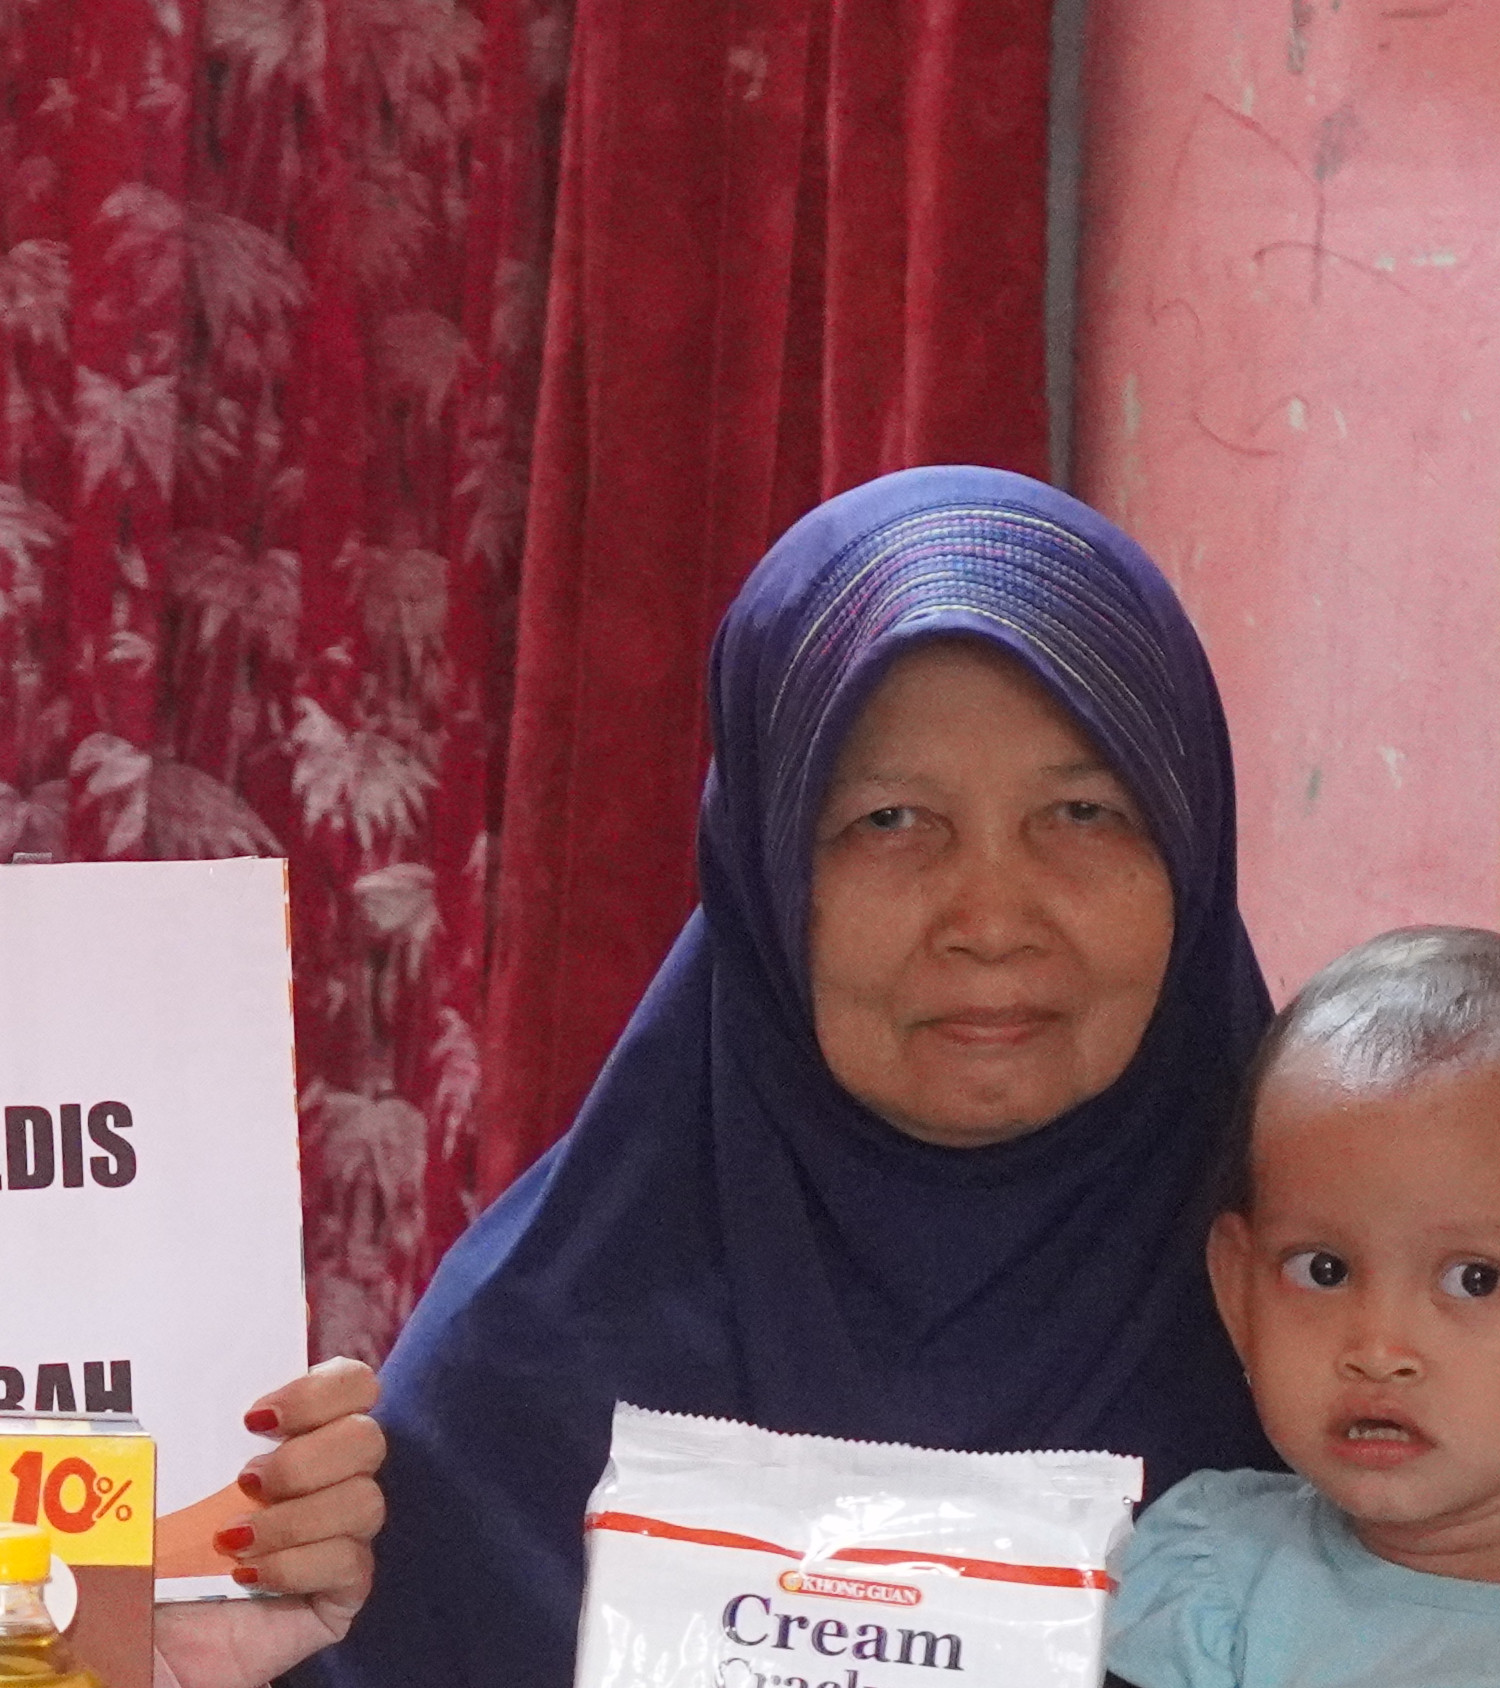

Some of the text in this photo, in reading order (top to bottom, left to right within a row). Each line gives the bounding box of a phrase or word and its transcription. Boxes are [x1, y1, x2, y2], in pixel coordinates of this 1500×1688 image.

[10, 1450, 134, 1534] 10%
[802, 1575, 919, 1605] KHONG GUAN
[722, 1593, 964, 1671] Cream
